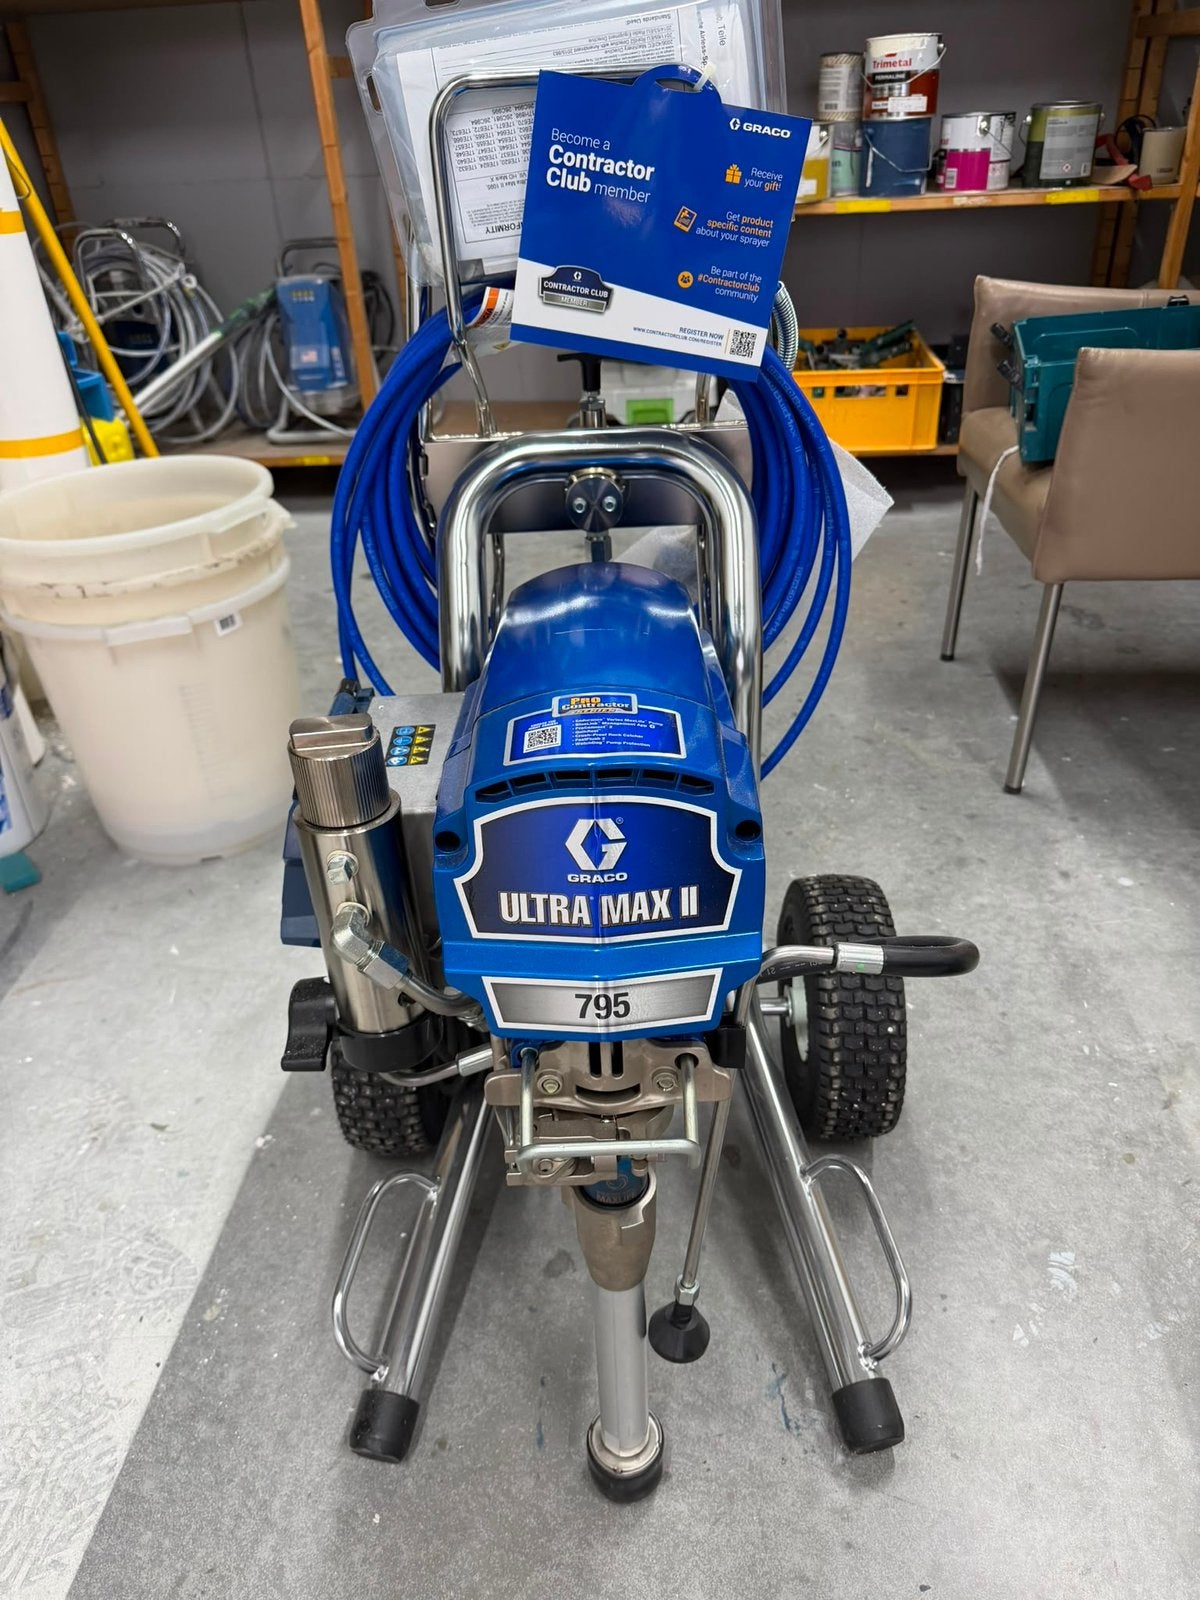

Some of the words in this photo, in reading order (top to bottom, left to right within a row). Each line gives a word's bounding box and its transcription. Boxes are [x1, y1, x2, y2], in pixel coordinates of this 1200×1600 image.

[625, 17, 641, 25] Used:
[642, 12, 671, 22] Standards
[587, 35, 607, 43] Directive
[608, 39, 629, 47] Directive
[717, 26, 727, 46] Teile
[573, 43, 599, 52] Amendment
[603, 46, 623, 54] Directive
[697, 30, 710, 68] Airless-Sp
[872, 58, 912, 69] Trimetal
[743, 122, 792, 139] GRACO
[551, 128, 600, 149] Become
[603, 140, 611, 151] a
[548, 144, 655, 181] Contractor
[751, 167, 783, 182] Receive
[546, 166, 591, 193] Club
[594, 183, 651, 203] member
[744, 178, 764, 188] your
[764, 181, 781, 192] gift!
[484, 221, 523, 233] FORMITY
[726, 211, 740, 222] Get
[741, 215, 774, 228] product
[707, 219, 738, 232] specific
[740, 225, 772, 238] content
[695, 226, 719, 238] about
[720, 232, 738, 241] your
[740, 235, 770, 248] sprayer
[710, 265, 721, 275] Be
[722, 269, 738, 279] part
[740, 271, 749, 280] of
[749, 273, 762, 283] the
[543, 280, 590, 295] CONTRACTOR
[590, 288, 609, 298] CLUB
[697, 273, 760, 292] #Contractorclub
[561, 296, 588, 307] MEMBER
[715, 287, 759, 304] community
[679, 327, 708, 338] REGISTER
[709, 332, 724, 341] NOW
[561, 702, 630, 710] Contractor
[570, 697, 600, 705] PRO
[567, 872, 628, 883] GRACO
[498, 891, 593, 928] ULTRA
[601, 887, 672, 927] MAX
[679, 885, 700, 919] II
[574, 992, 631, 1020] 795
